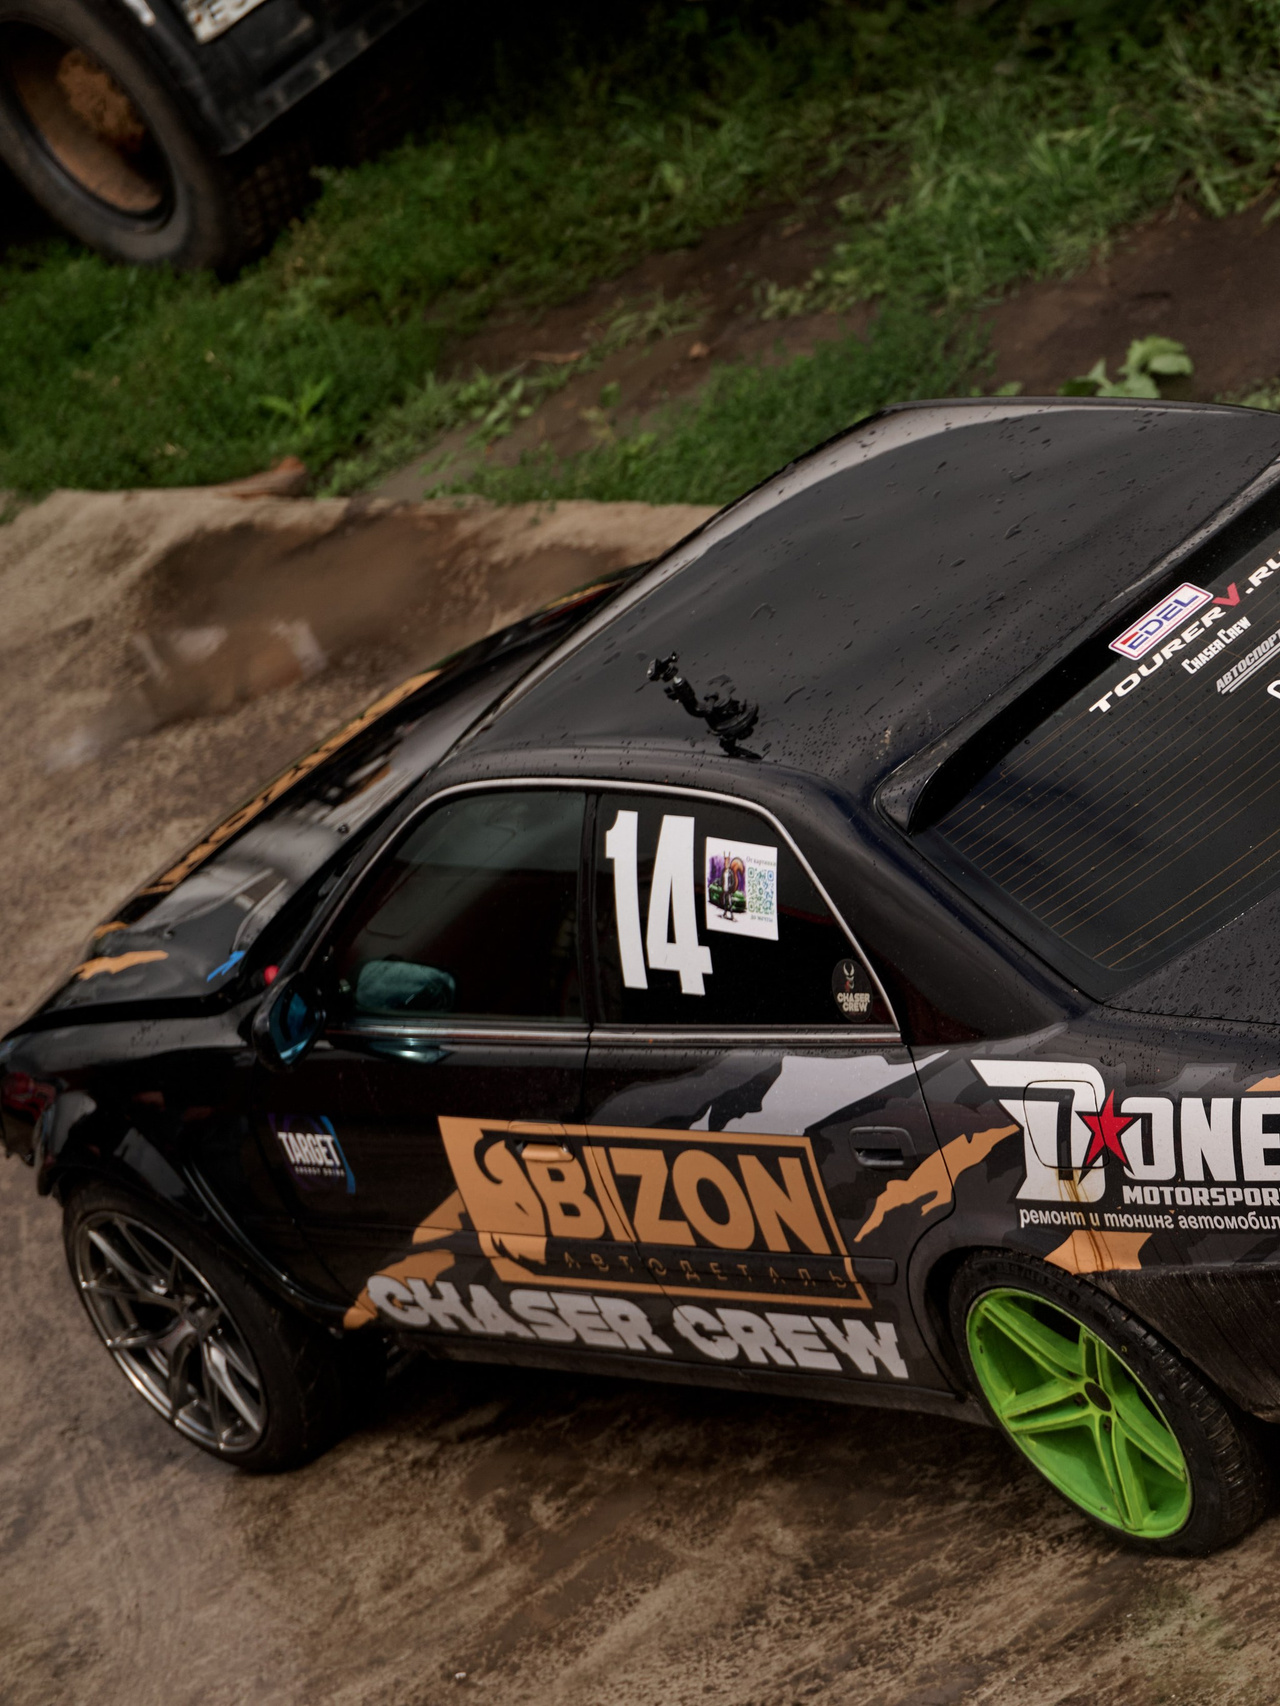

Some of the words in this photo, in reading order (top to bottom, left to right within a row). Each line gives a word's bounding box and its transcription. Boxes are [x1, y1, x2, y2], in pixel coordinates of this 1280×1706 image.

[1120, 595, 1199, 651] EDEL
[605, 809, 714, 996] 14
[837, 992, 871, 1003] CHASER
[842, 1001, 868, 1013] CREW
[277, 1131, 342, 1168] TARGET
[528, 1145, 834, 1256] BIZON
[1019, 1207, 1087, 1229] ремонт
[1089, 1210, 1101, 1228] и
[1103, 1211, 1175, 1230] тюнинг
[367, 1274, 674, 1355] CHASER
[672, 1305, 909, 1380] CREW
